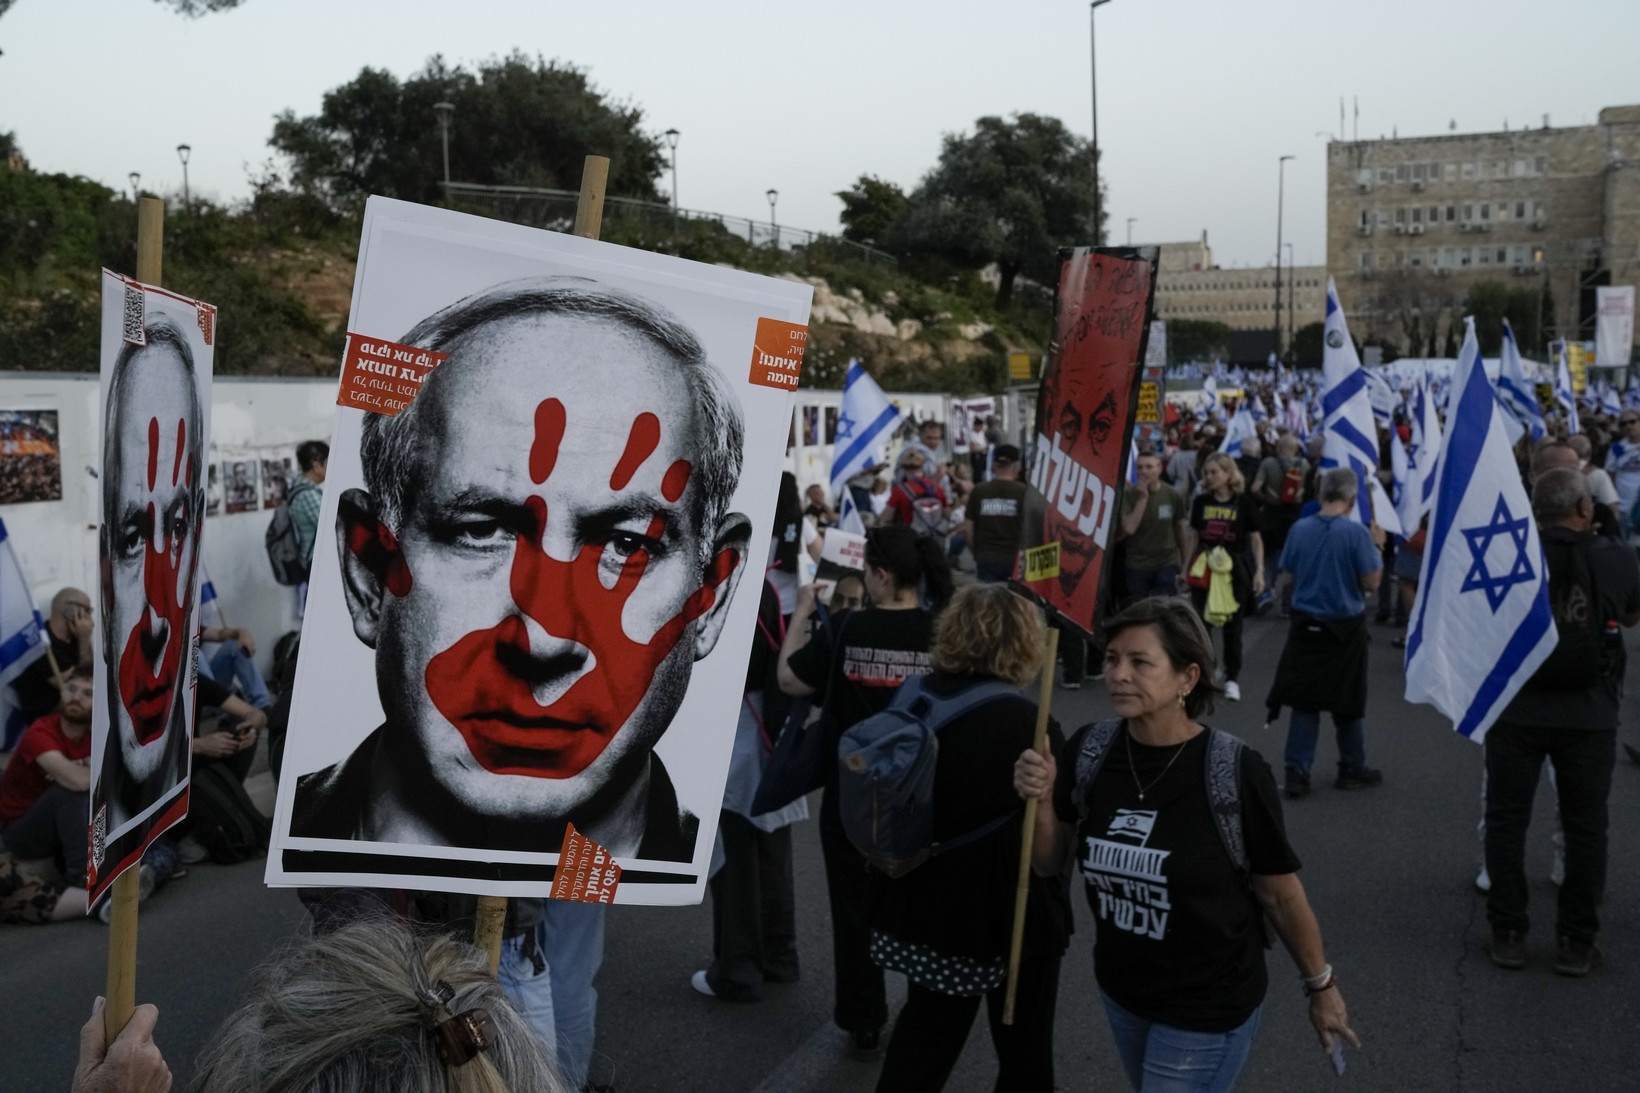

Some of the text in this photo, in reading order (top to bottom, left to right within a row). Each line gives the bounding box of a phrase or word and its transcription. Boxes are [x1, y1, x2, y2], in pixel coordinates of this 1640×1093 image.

[360, 343, 390, 359] סרקו
[393, 350, 414, 363] את
[758, 352, 798, 371] איתנו!
[356, 358, 397, 378] אנחנו
[353, 375, 367, 388] על
[369, 379, 394, 392] עתיד
[767, 371, 799, 386] תרומה
[350, 390, 382, 408] בשביל
[1030, 431, 1115, 551] נכשלת
[563, 839, 579, 873] להמשיך
[585, 867, 602, 897] אותך
[1084, 870, 1171, 910] בחירות
[1098, 892, 1168, 941] עכשיו
